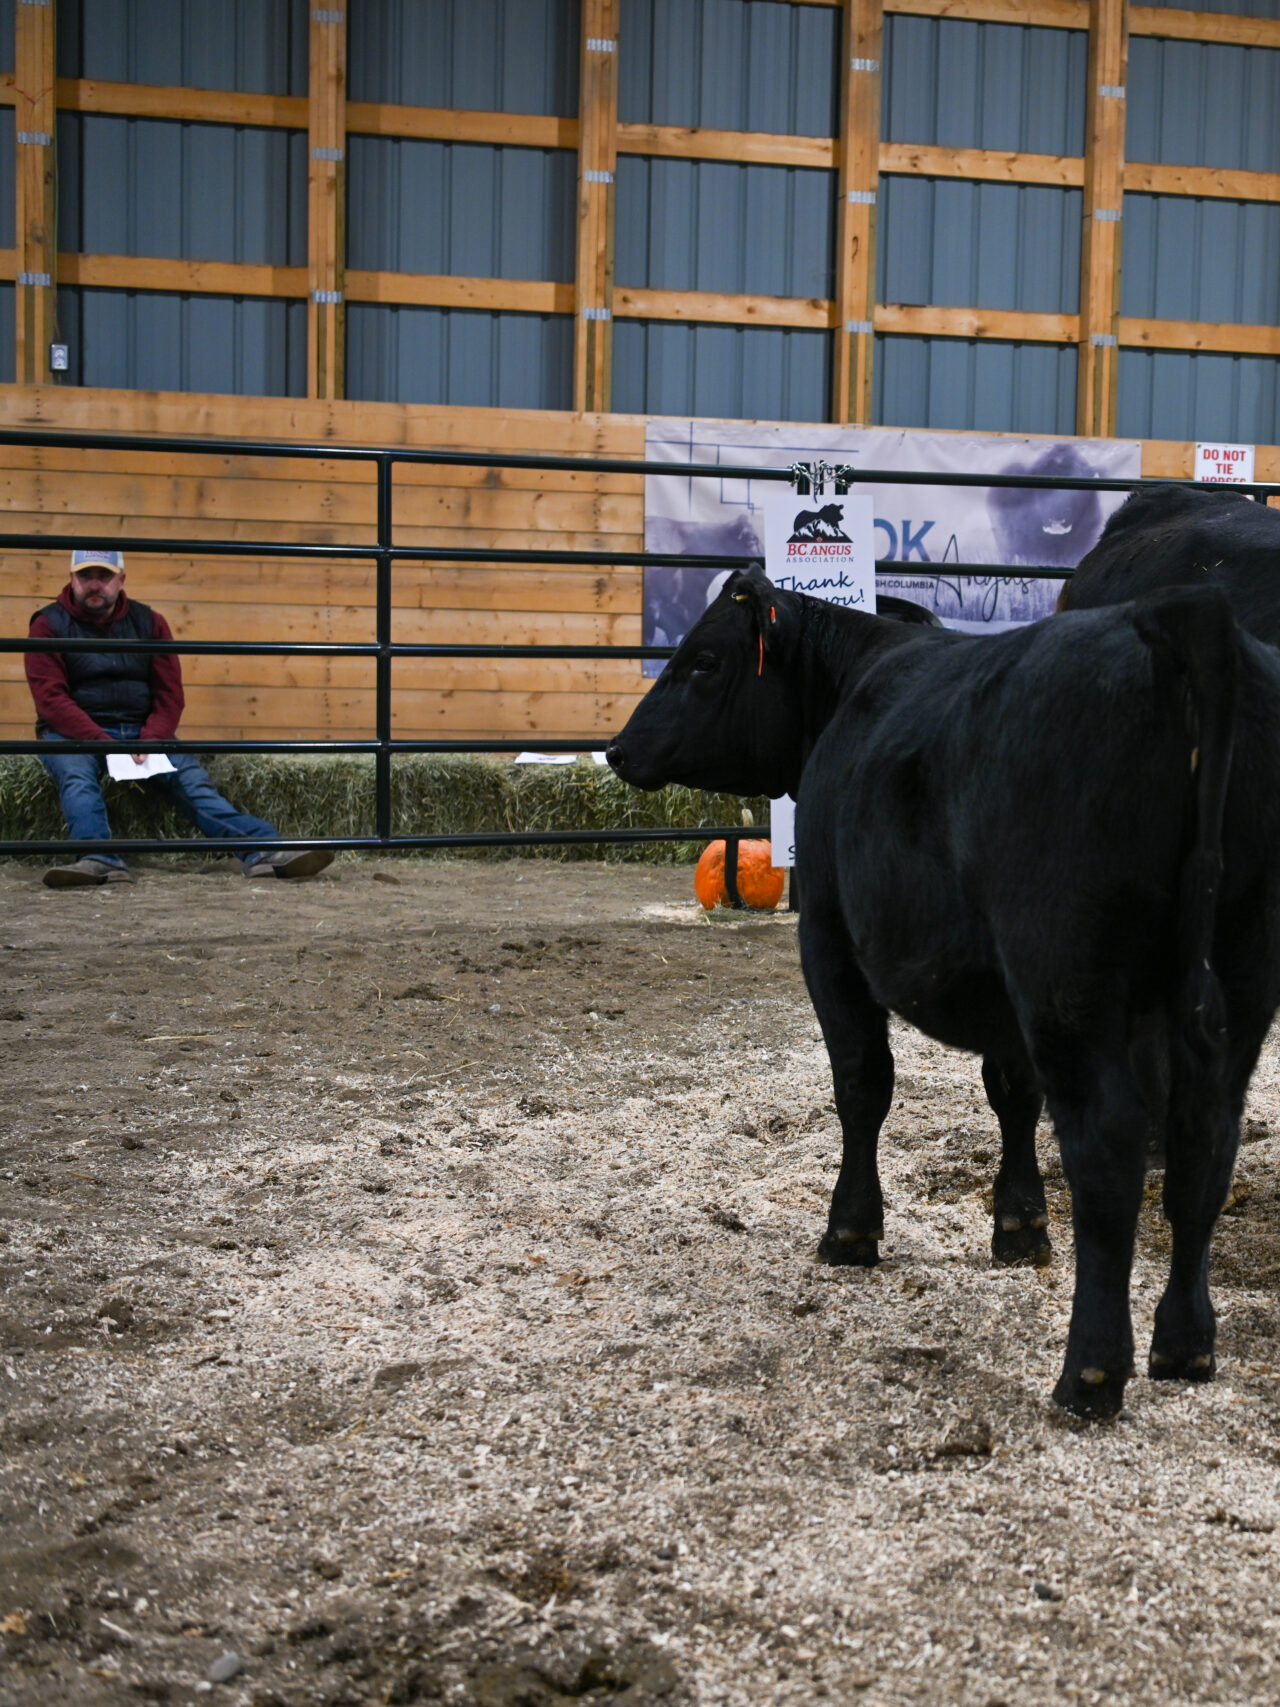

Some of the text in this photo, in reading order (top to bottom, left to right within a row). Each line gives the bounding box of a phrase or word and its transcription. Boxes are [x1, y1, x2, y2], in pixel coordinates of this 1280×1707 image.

[1203, 449, 1246, 461] DO NOT
[1216, 463, 1233, 474] TIE
[787, 543, 852, 556] BC ANGUS
[786, 556, 854, 564] ASSOCIATION
[775, 571, 854, 592] Thank
[888, 581, 935, 590] COLUMBIA
